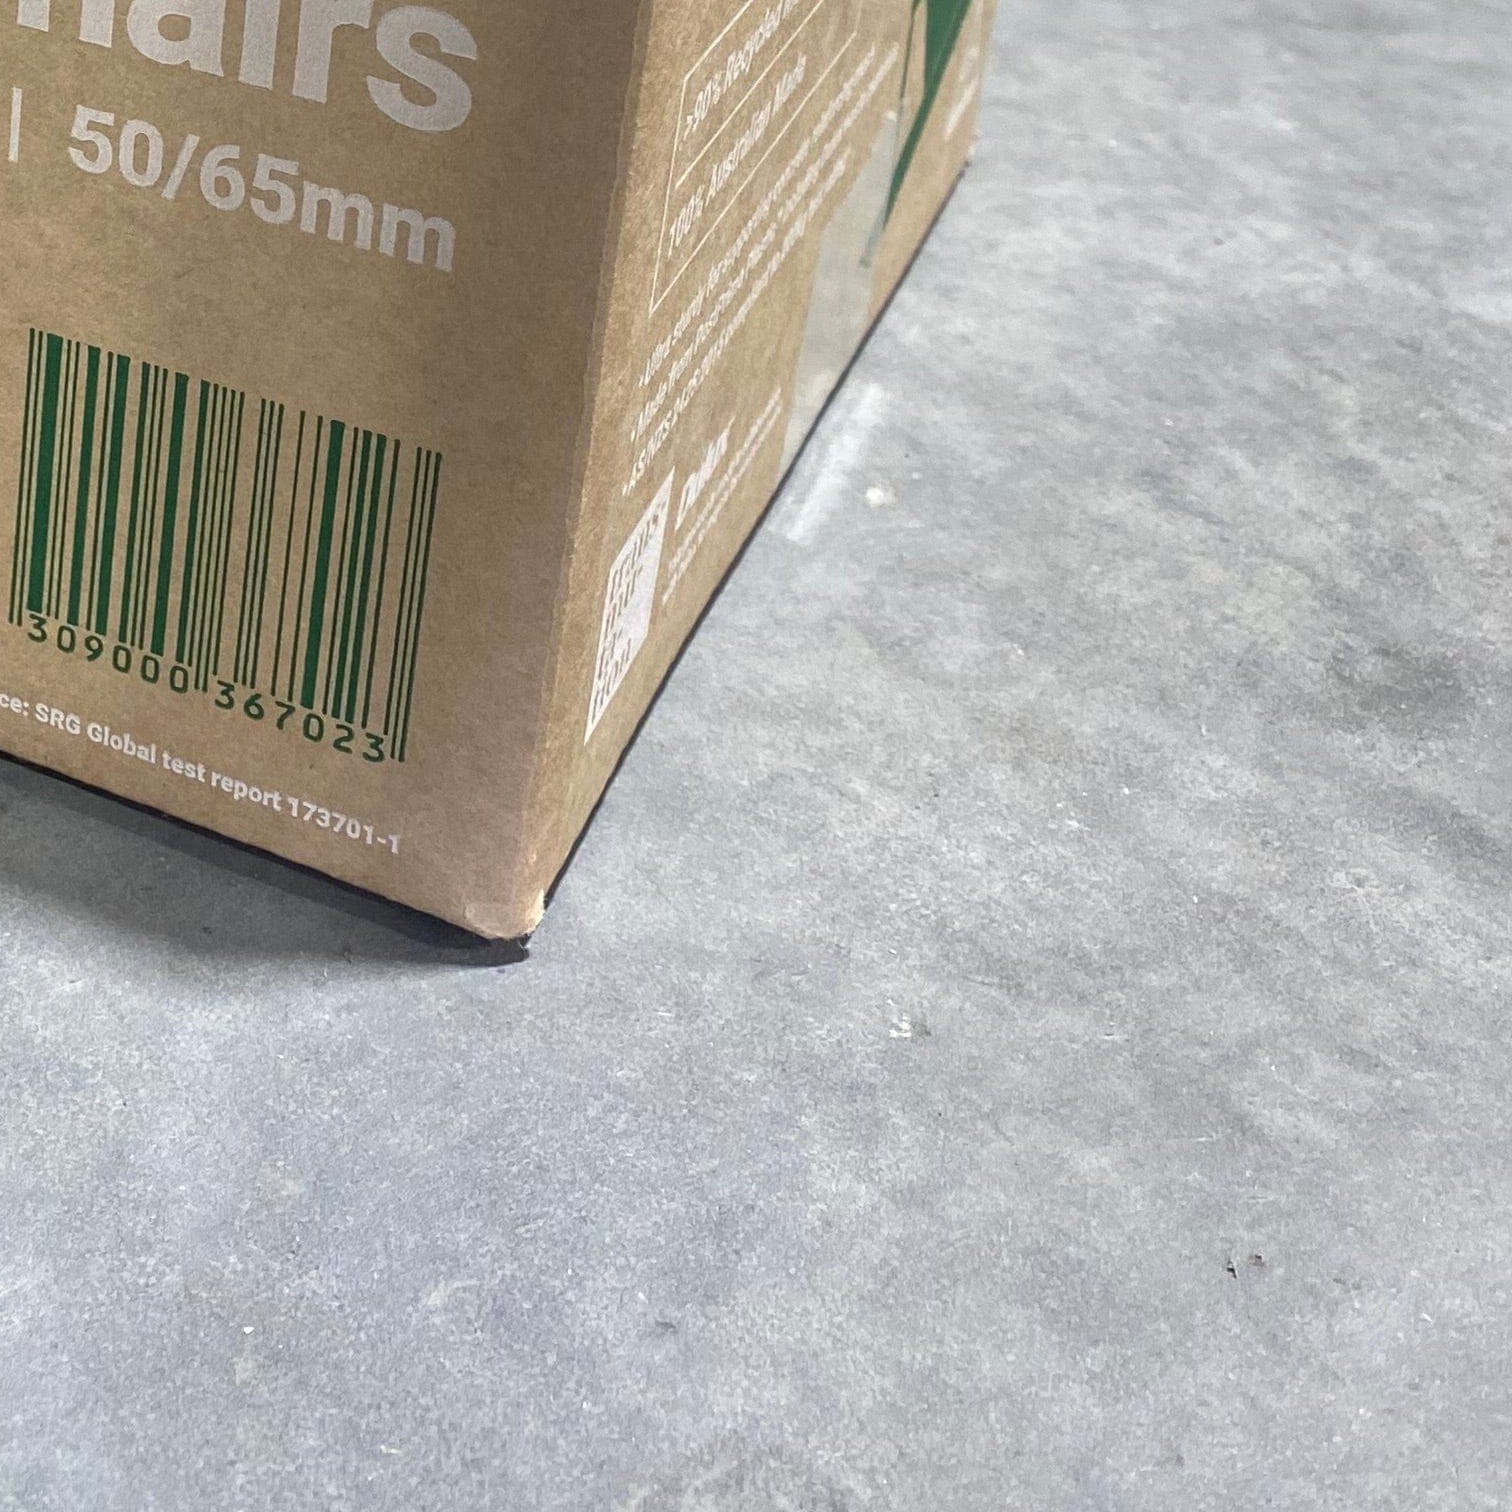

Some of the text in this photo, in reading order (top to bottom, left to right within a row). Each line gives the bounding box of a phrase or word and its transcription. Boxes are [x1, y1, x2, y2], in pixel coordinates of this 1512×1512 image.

[723, 7, 781, 94] Recycled
[67, 103, 458, 274] 50/65mm
[34, 703, 82, 736] SRG
[87, 720, 157, 765] Global
[161, 748, 206, 783] test
[210, 768, 283, 812] report
[287, 795, 401, 855] 173701-1
